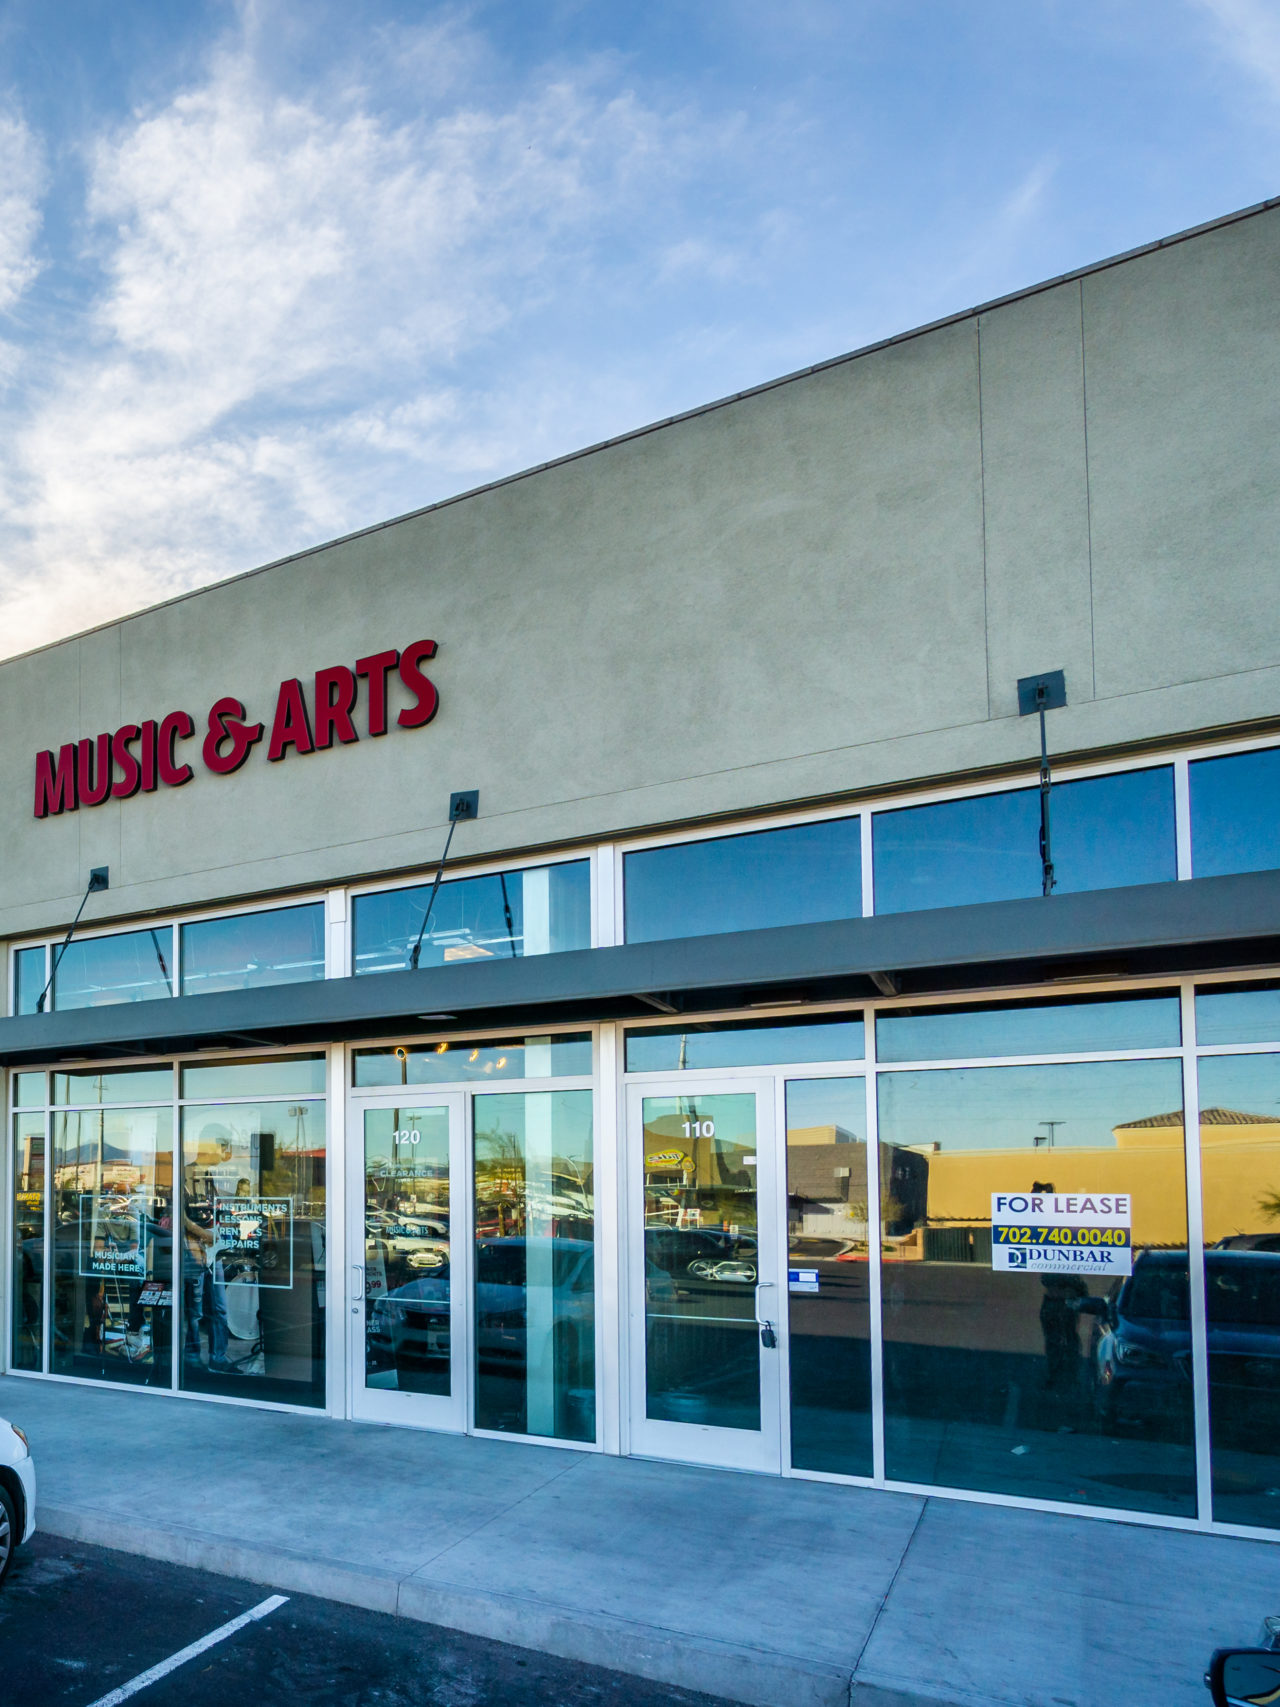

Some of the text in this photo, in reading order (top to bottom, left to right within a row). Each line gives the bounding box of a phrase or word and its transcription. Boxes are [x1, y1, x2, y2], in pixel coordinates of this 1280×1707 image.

[33, 639, 441, 819] MUSIC & ARTS
[682, 1121, 715, 1138] 110
[393, 1130, 420, 1144] 120
[219, 1203, 288, 1213] INSTRUMENTS
[996, 1196, 1128, 1215] FOR LEASE
[219, 1215, 263, 1224] LESSONS
[998, 1227, 1126, 1246] 702.740.0040
[220, 1240, 260, 1249] REPAIRS
[94, 1251, 140, 1260] MUSICIANS
[1028, 1248, 1115, 1263] DUNBAR
[92, 1262, 141, 1272] MADE HERE
[1030, 1261, 1108, 1272] commercial
